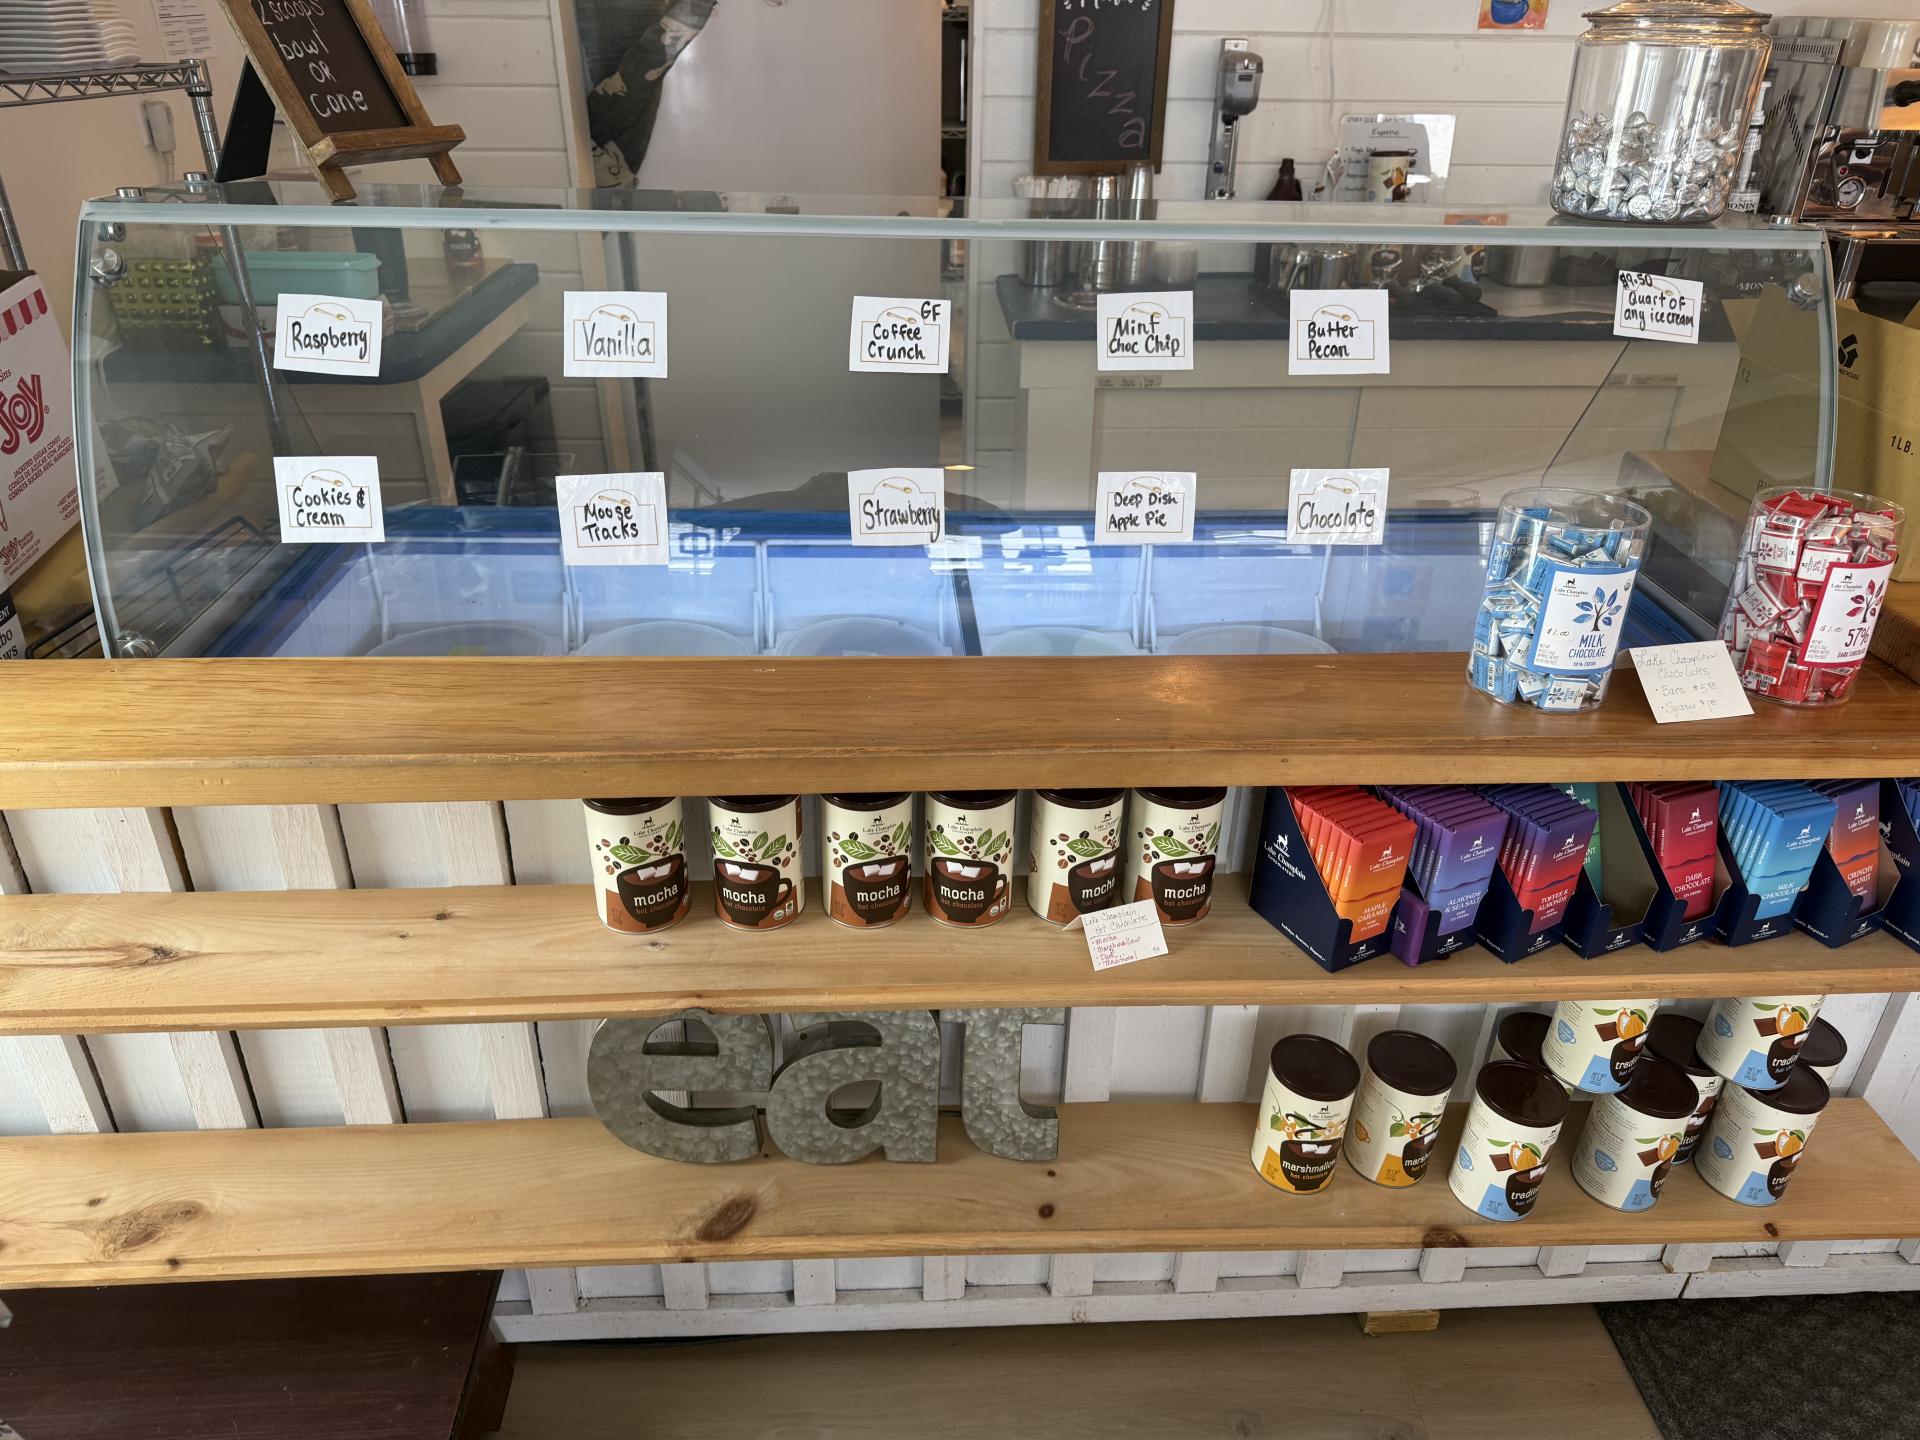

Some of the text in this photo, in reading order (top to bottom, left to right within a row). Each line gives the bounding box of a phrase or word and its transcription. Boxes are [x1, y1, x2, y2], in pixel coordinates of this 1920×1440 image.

[272, 28, 330, 61] bowl
[308, 60, 337, 84] OR
[1058, 15, 1145, 149] Pizza
[309, 90, 369, 118] Cone
[1619, 272, 1653, 290] $9.50
[1628, 290, 1666, 308] Quart
[920, 300, 942, 322] GF
[1623, 308, 1646, 331] any
[872, 323, 923, 341] Coffee
[1112, 314, 1160, 341] Mint
[1307, 321, 1359, 339] Butter
[582, 321, 652, 358] Vanilla
[1108, 333, 1181, 358] Choc Chip
[867, 340, 926, 361] Crunch
[1308, 339, 1351, 360] Pecan
[292, 486, 352, 507] Cookies
[1113, 491, 1178, 508] Deep Dish
[296, 508, 346, 528] Cream
[583, 502, 634, 523] Moose
[1108, 508, 1168, 532] Apple Pie
[1298, 500, 1375, 530] Chocolate
[581, 520, 639, 542] Tracks
[1578, 633, 1605, 648] MILK
[1844, 626, 1870, 648] 57%
[1568, 646, 1607, 658] CHOCOLATE
[1263, 841, 1307, 881] Lake Champlain
[1685, 871, 1703, 883] DARK
[1847, 864, 1874, 881] CRUNCHY
[1850, 873, 1871, 887] PEANUT
[856, 884, 900, 902] mocha
[940, 884, 985, 901] mocha
[1164, 883, 1206, 899] mocha
[1674, 876, 1712, 893] CHOCOLATE
[1777, 882, 1795, 891] MILK
[633, 883, 679, 907] mocha
[722, 886, 767, 904] mocha
[1448, 891, 1482, 906] ALMONDS
[1537, 895, 1568, 912] ALMONDS
[1540, 890, 1563, 904] TOFFEE
[1363, 902, 1387, 914] MAPLE
[1450, 902, 1464, 913] SEA
[1463, 897, 1481, 909] SALT
[1357, 908, 1389, 923] CARAMEL
[1095, 934, 1118, 946] Mocha
[587, 1007, 1064, 1164] eat
